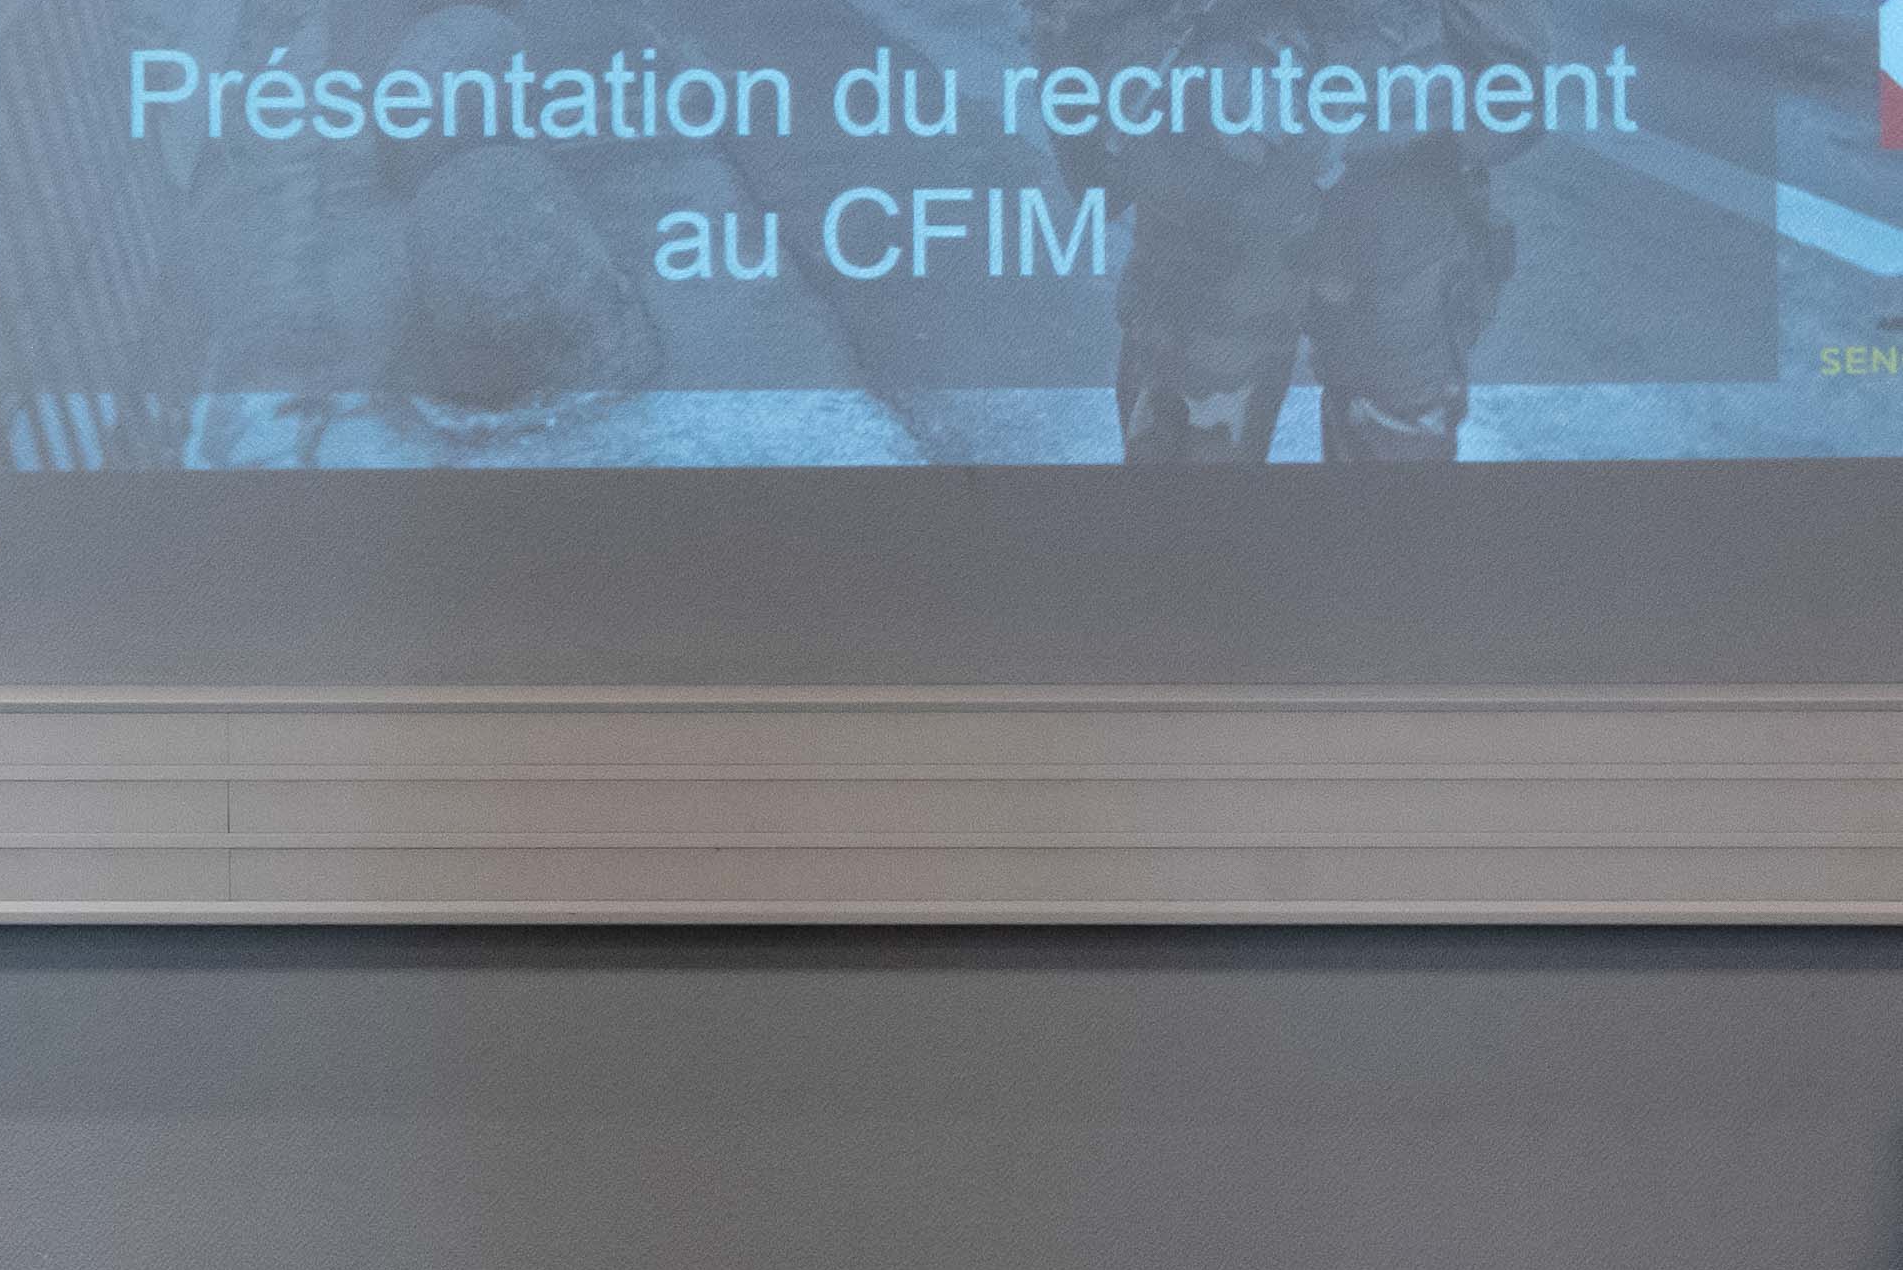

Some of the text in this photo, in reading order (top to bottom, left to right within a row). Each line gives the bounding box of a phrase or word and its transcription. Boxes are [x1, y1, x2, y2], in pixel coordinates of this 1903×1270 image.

[128, 45, 1639, 141] Présentation du recrutement
[652, 185, 1110, 282] au CFIM
[1819, 344, 1903, 377] SEN
